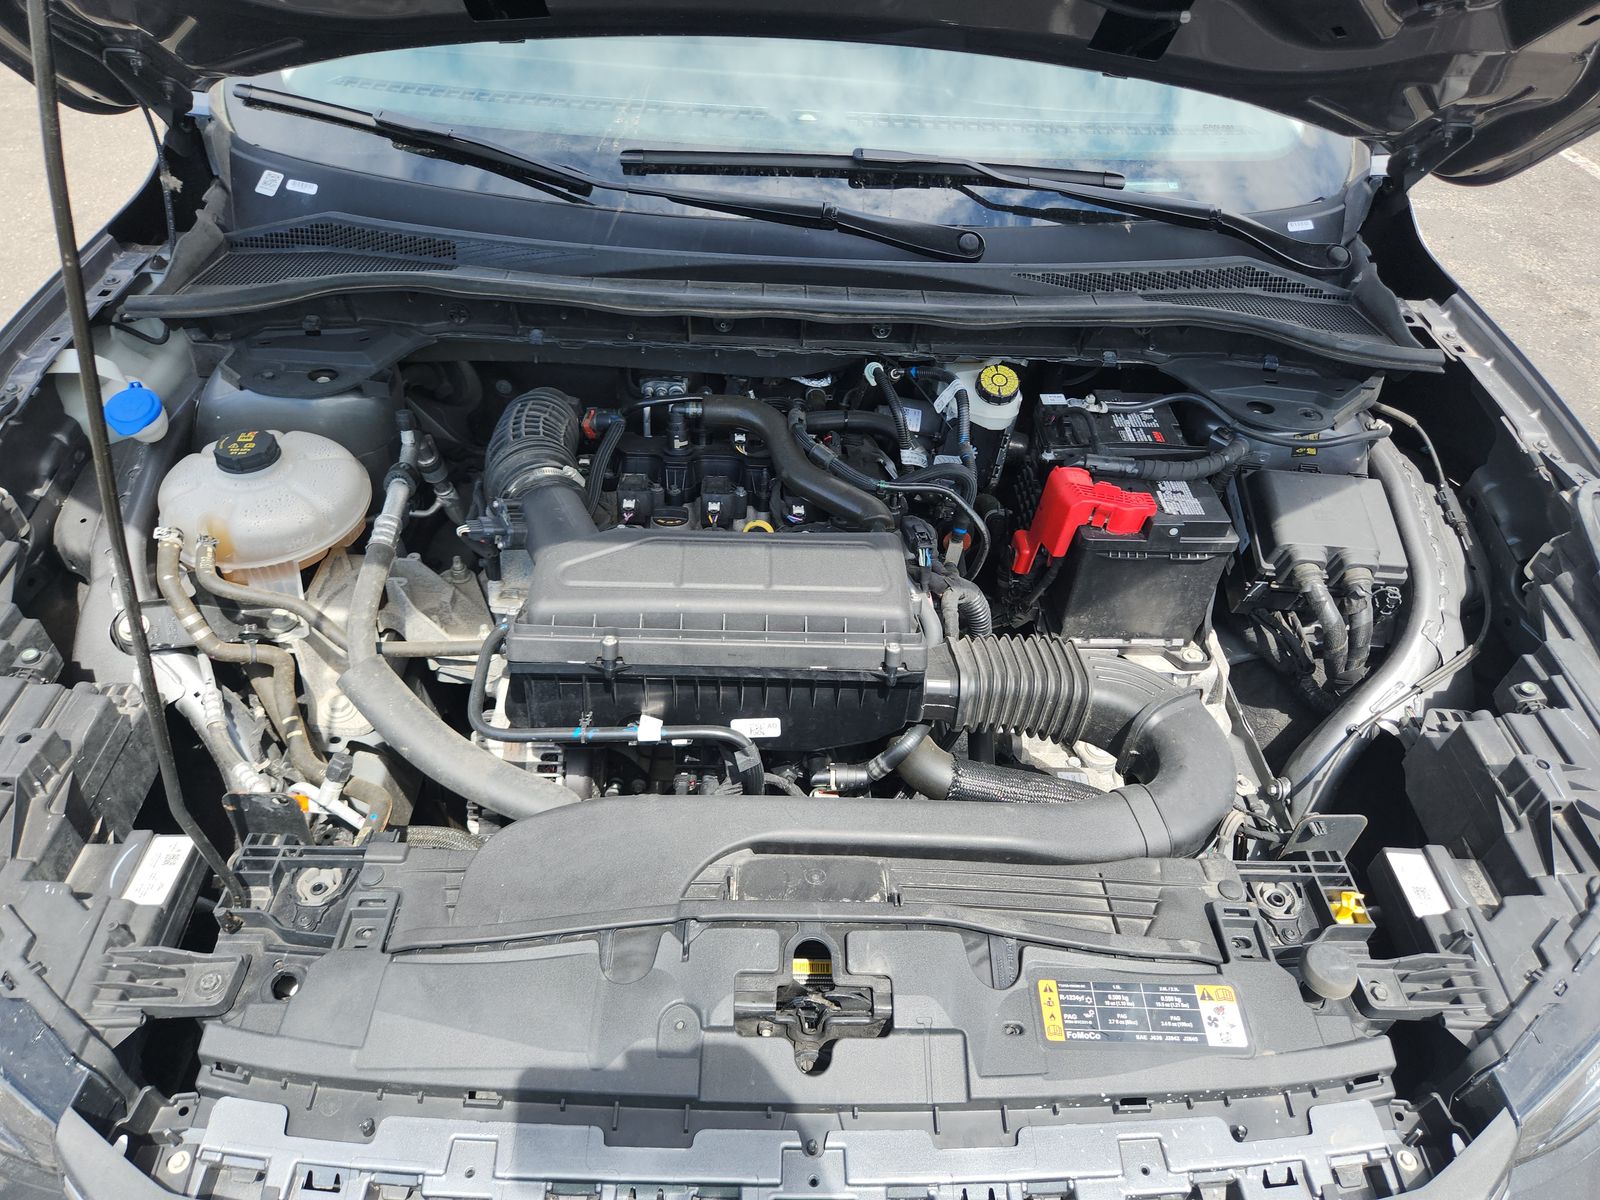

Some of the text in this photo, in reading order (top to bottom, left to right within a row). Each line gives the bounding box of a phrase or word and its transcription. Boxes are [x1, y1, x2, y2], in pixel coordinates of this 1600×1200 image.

[1121, 994, 1129, 1002] kg
[1174, 995, 1182, 1003] kg
[1066, 1031, 1101, 1040] FoMoCo
